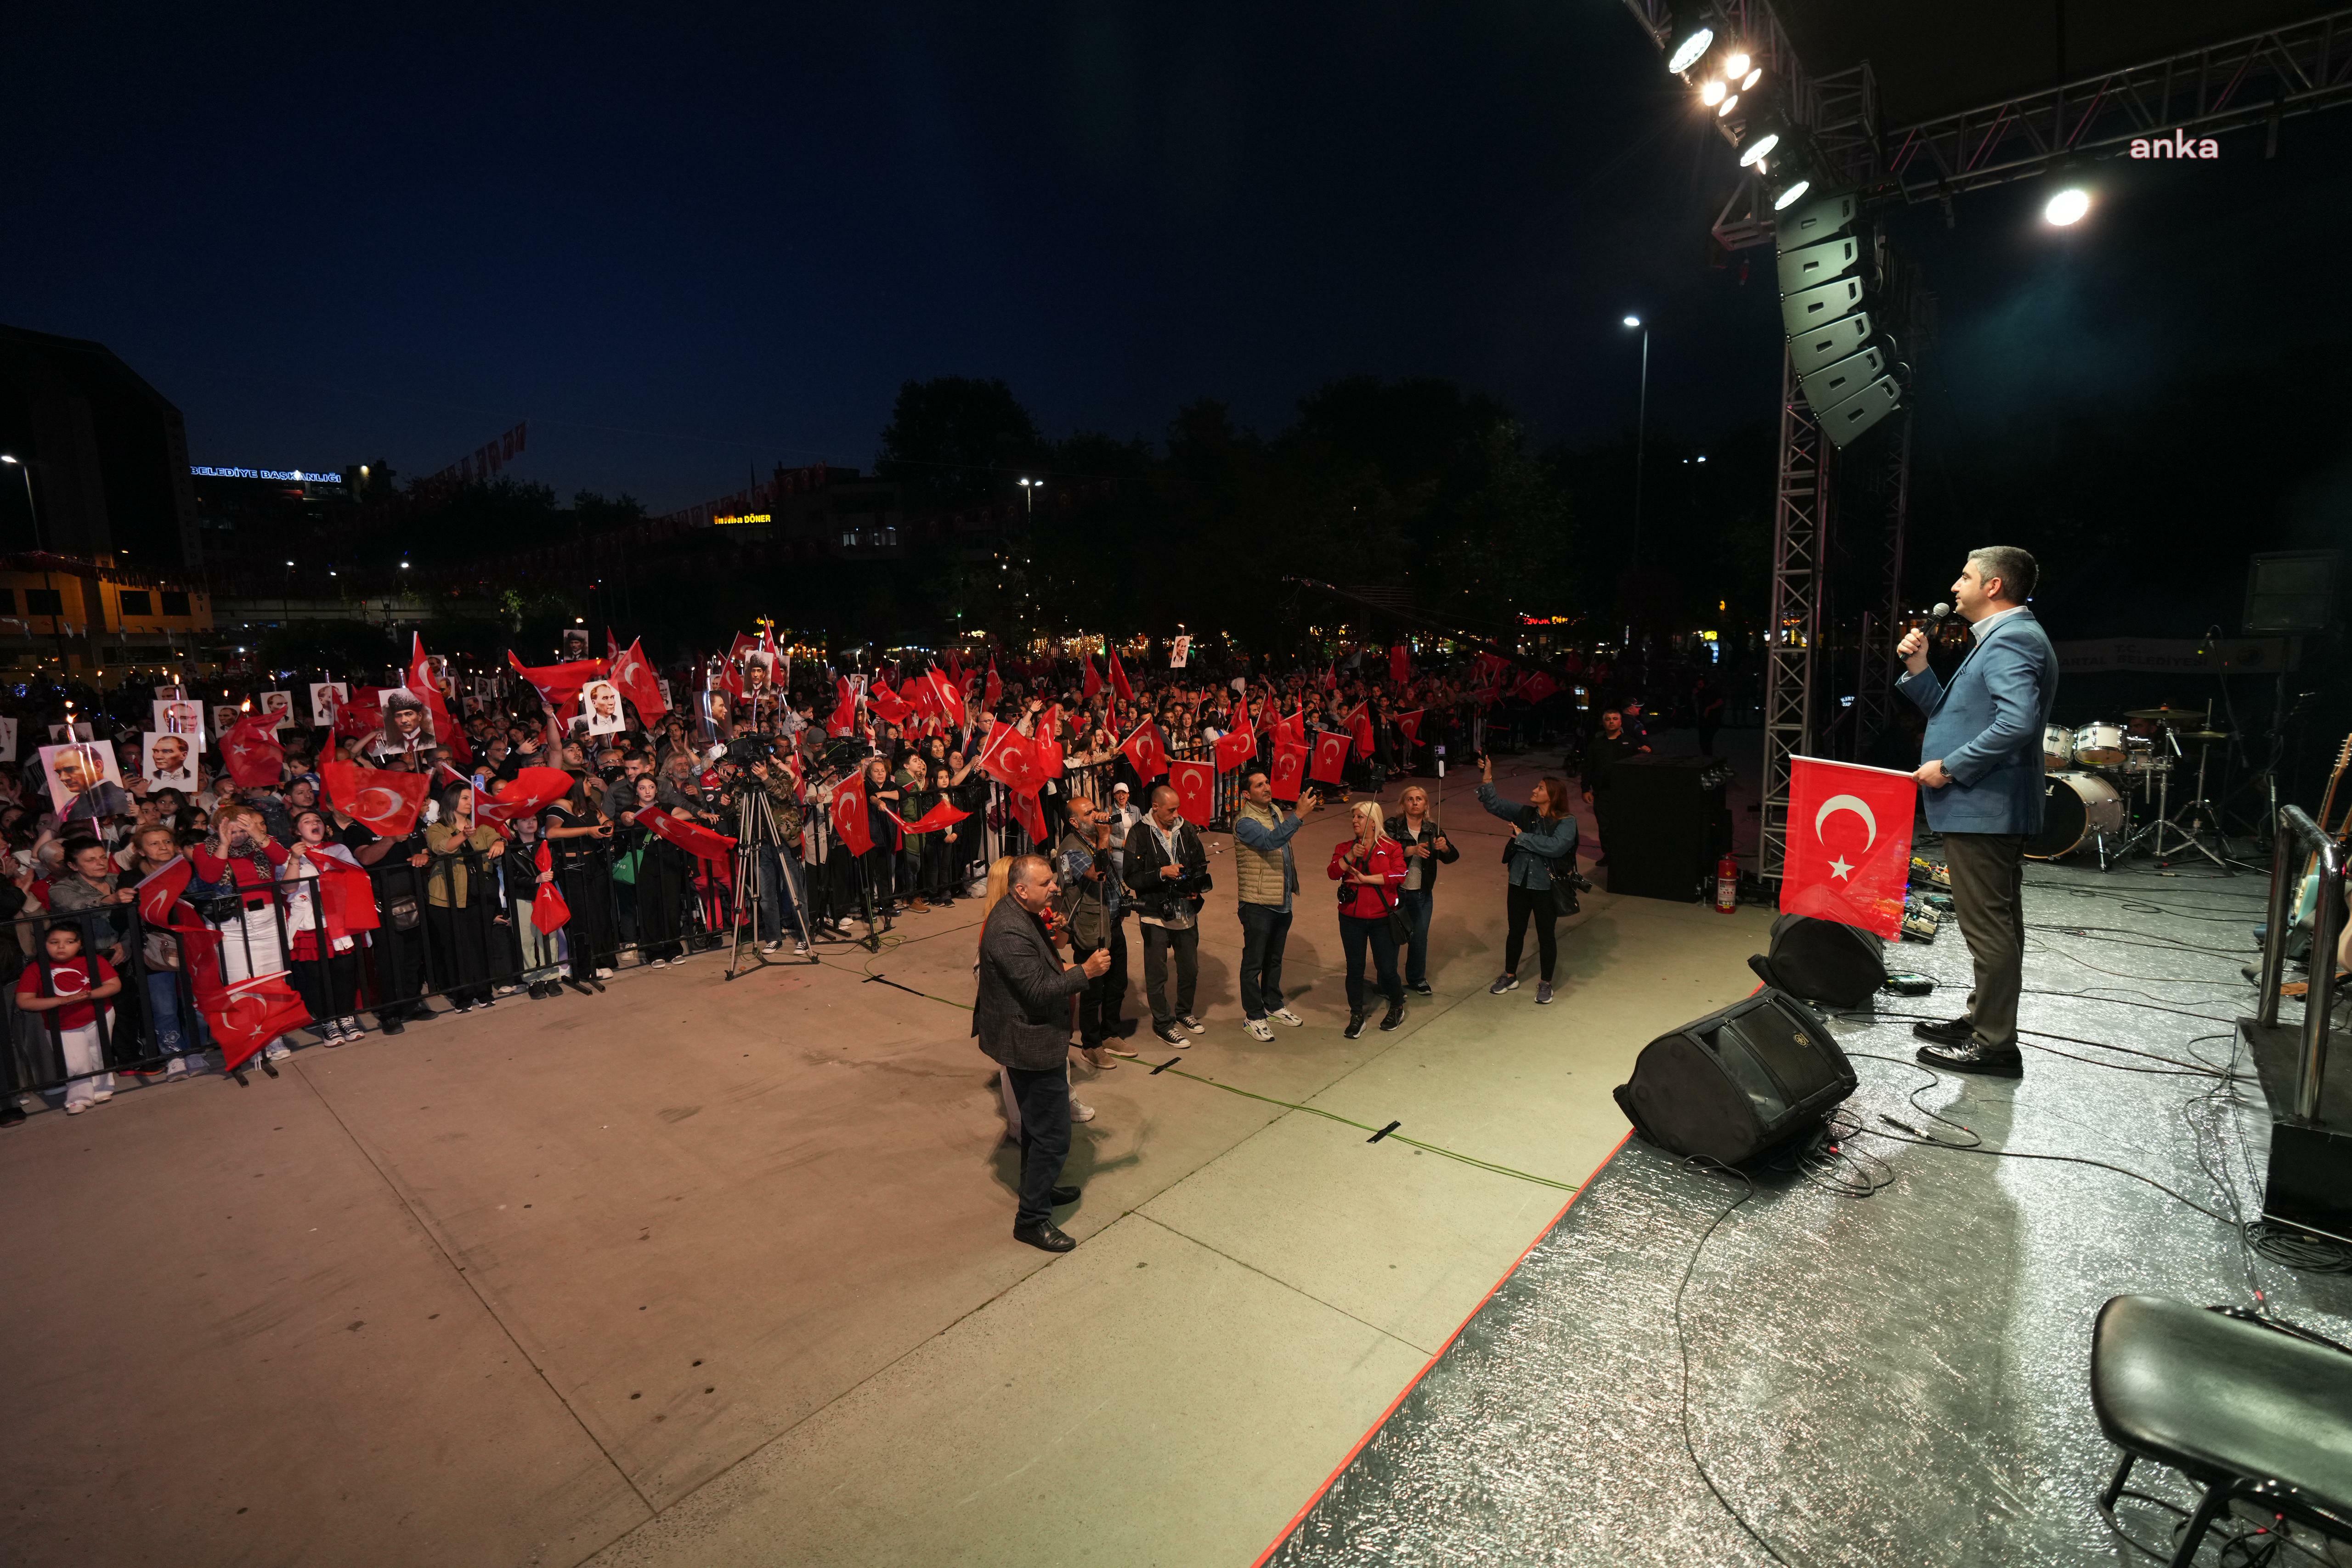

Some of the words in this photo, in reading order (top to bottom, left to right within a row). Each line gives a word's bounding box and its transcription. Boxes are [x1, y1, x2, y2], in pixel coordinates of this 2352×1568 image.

[190, 466, 258, 478] BELEDİYE
[260, 469, 342, 483] BAŞKANLIĞI
[744, 513, 770, 523] DÖNER
[2060, 657, 2107, 666] ARTAL
[2117, 655, 2208, 666] BELEDİYESİ
